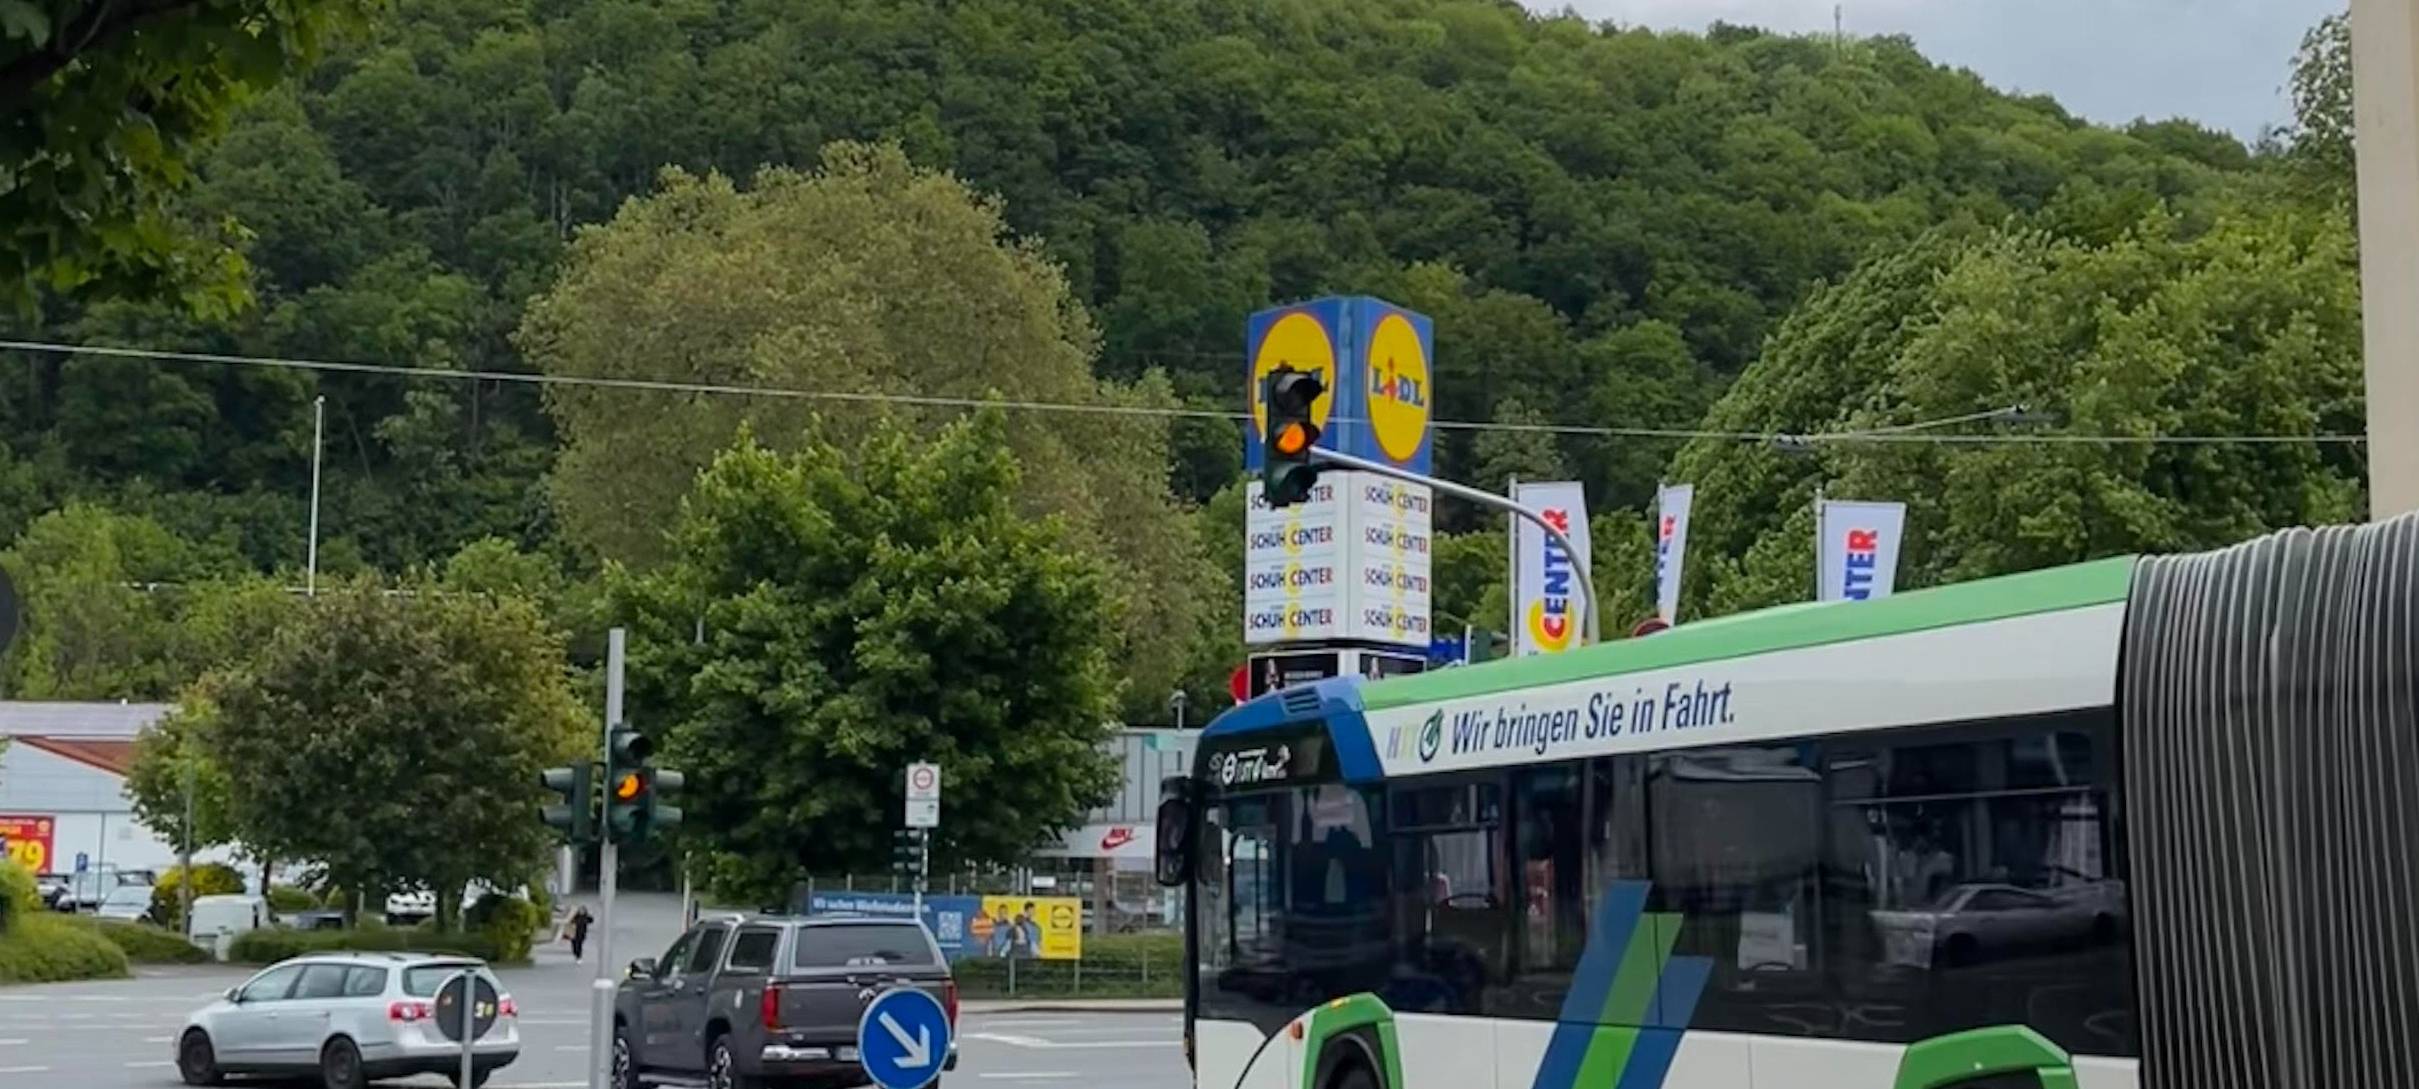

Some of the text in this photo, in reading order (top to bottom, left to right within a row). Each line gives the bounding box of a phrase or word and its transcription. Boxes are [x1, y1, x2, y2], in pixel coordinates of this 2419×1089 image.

[1397, 492, 1428, 513] CENTER
[1250, 526, 1333, 550] SCHUH CENTER
[1365, 526, 1427, 554] SCHUH CENTER
[1250, 567, 1333, 590] SCHUH CENTER
[1365, 568, 1427, 593] SCHUH CENTER
[1250, 608, 1333, 630] SCHUH CENTER
[1364, 608, 1427, 633] SCHUH CENTER
[1452, 710, 1490, 755] Wir
[1494, 703, 1578, 755] bringen
[1585, 692, 1624, 739] Sie
[1631, 688, 1655, 734] in
[1662, 679, 1735, 731] Fahrt.
